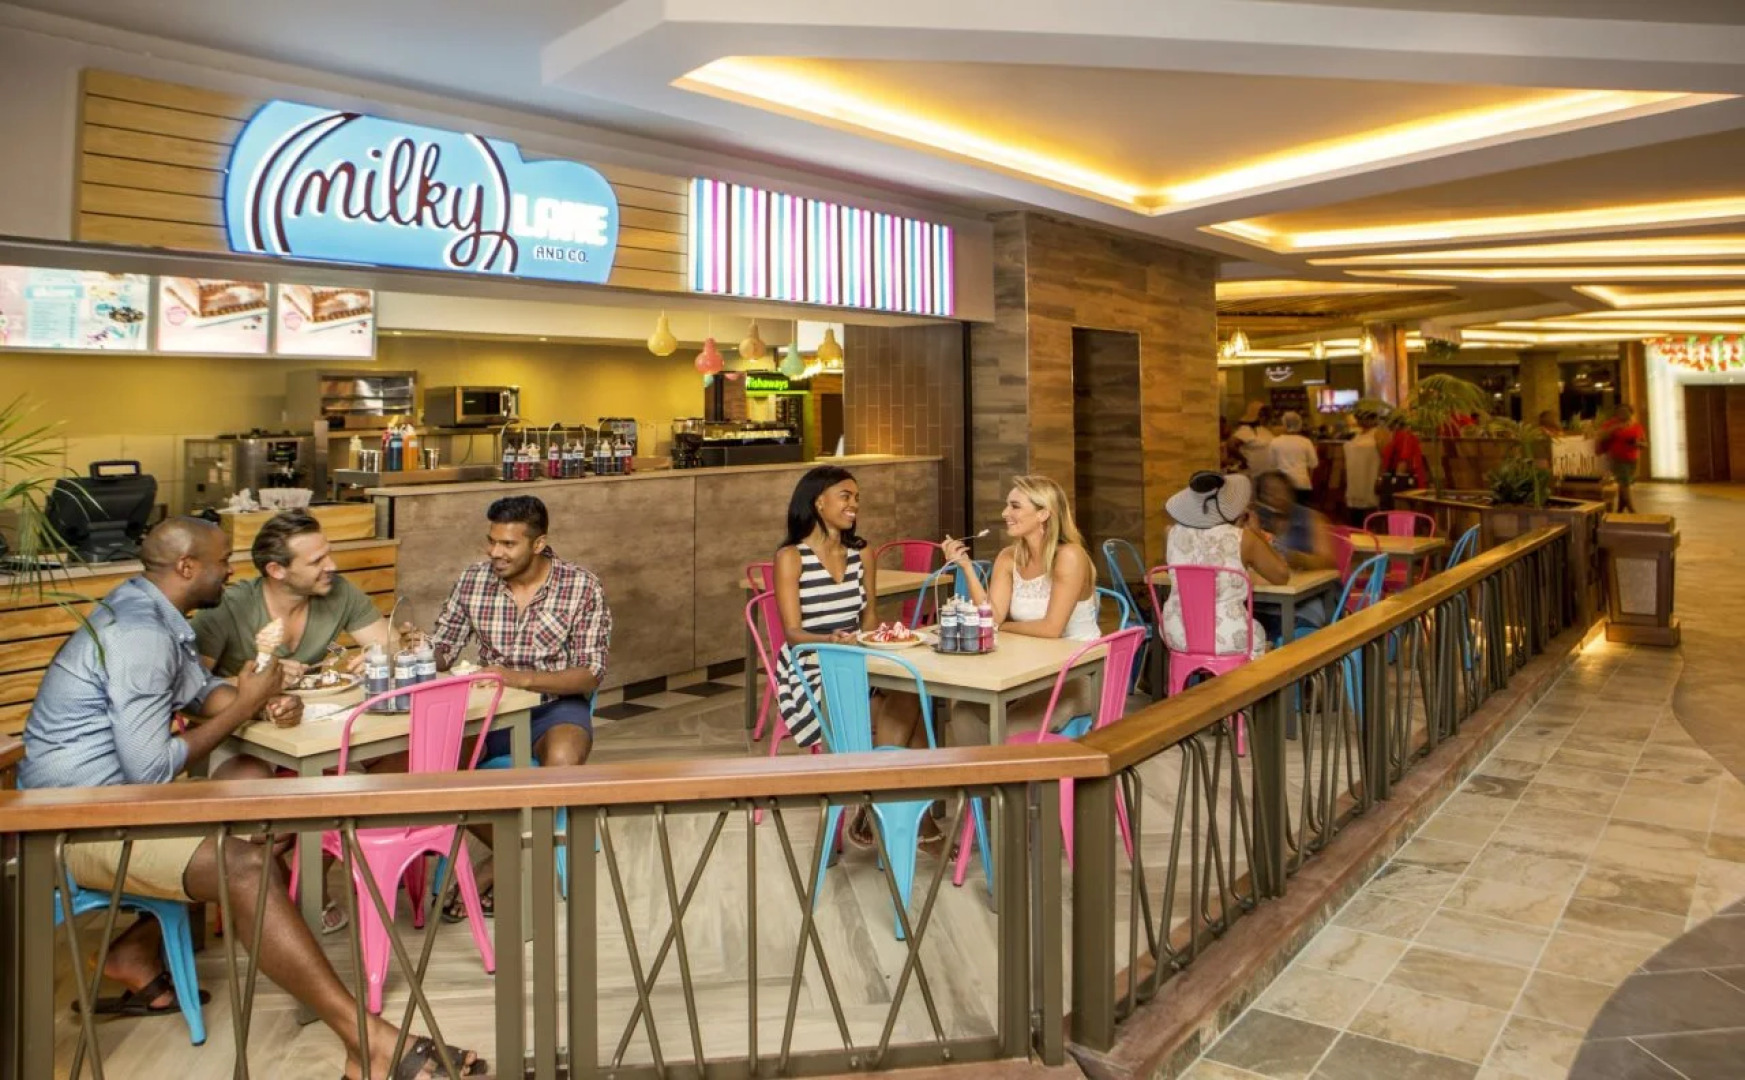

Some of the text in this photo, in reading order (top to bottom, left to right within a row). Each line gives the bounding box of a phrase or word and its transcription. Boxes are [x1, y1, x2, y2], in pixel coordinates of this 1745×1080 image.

[293, 137, 608, 268] milky LANE
[535, 246, 589, 262] AND CO.
